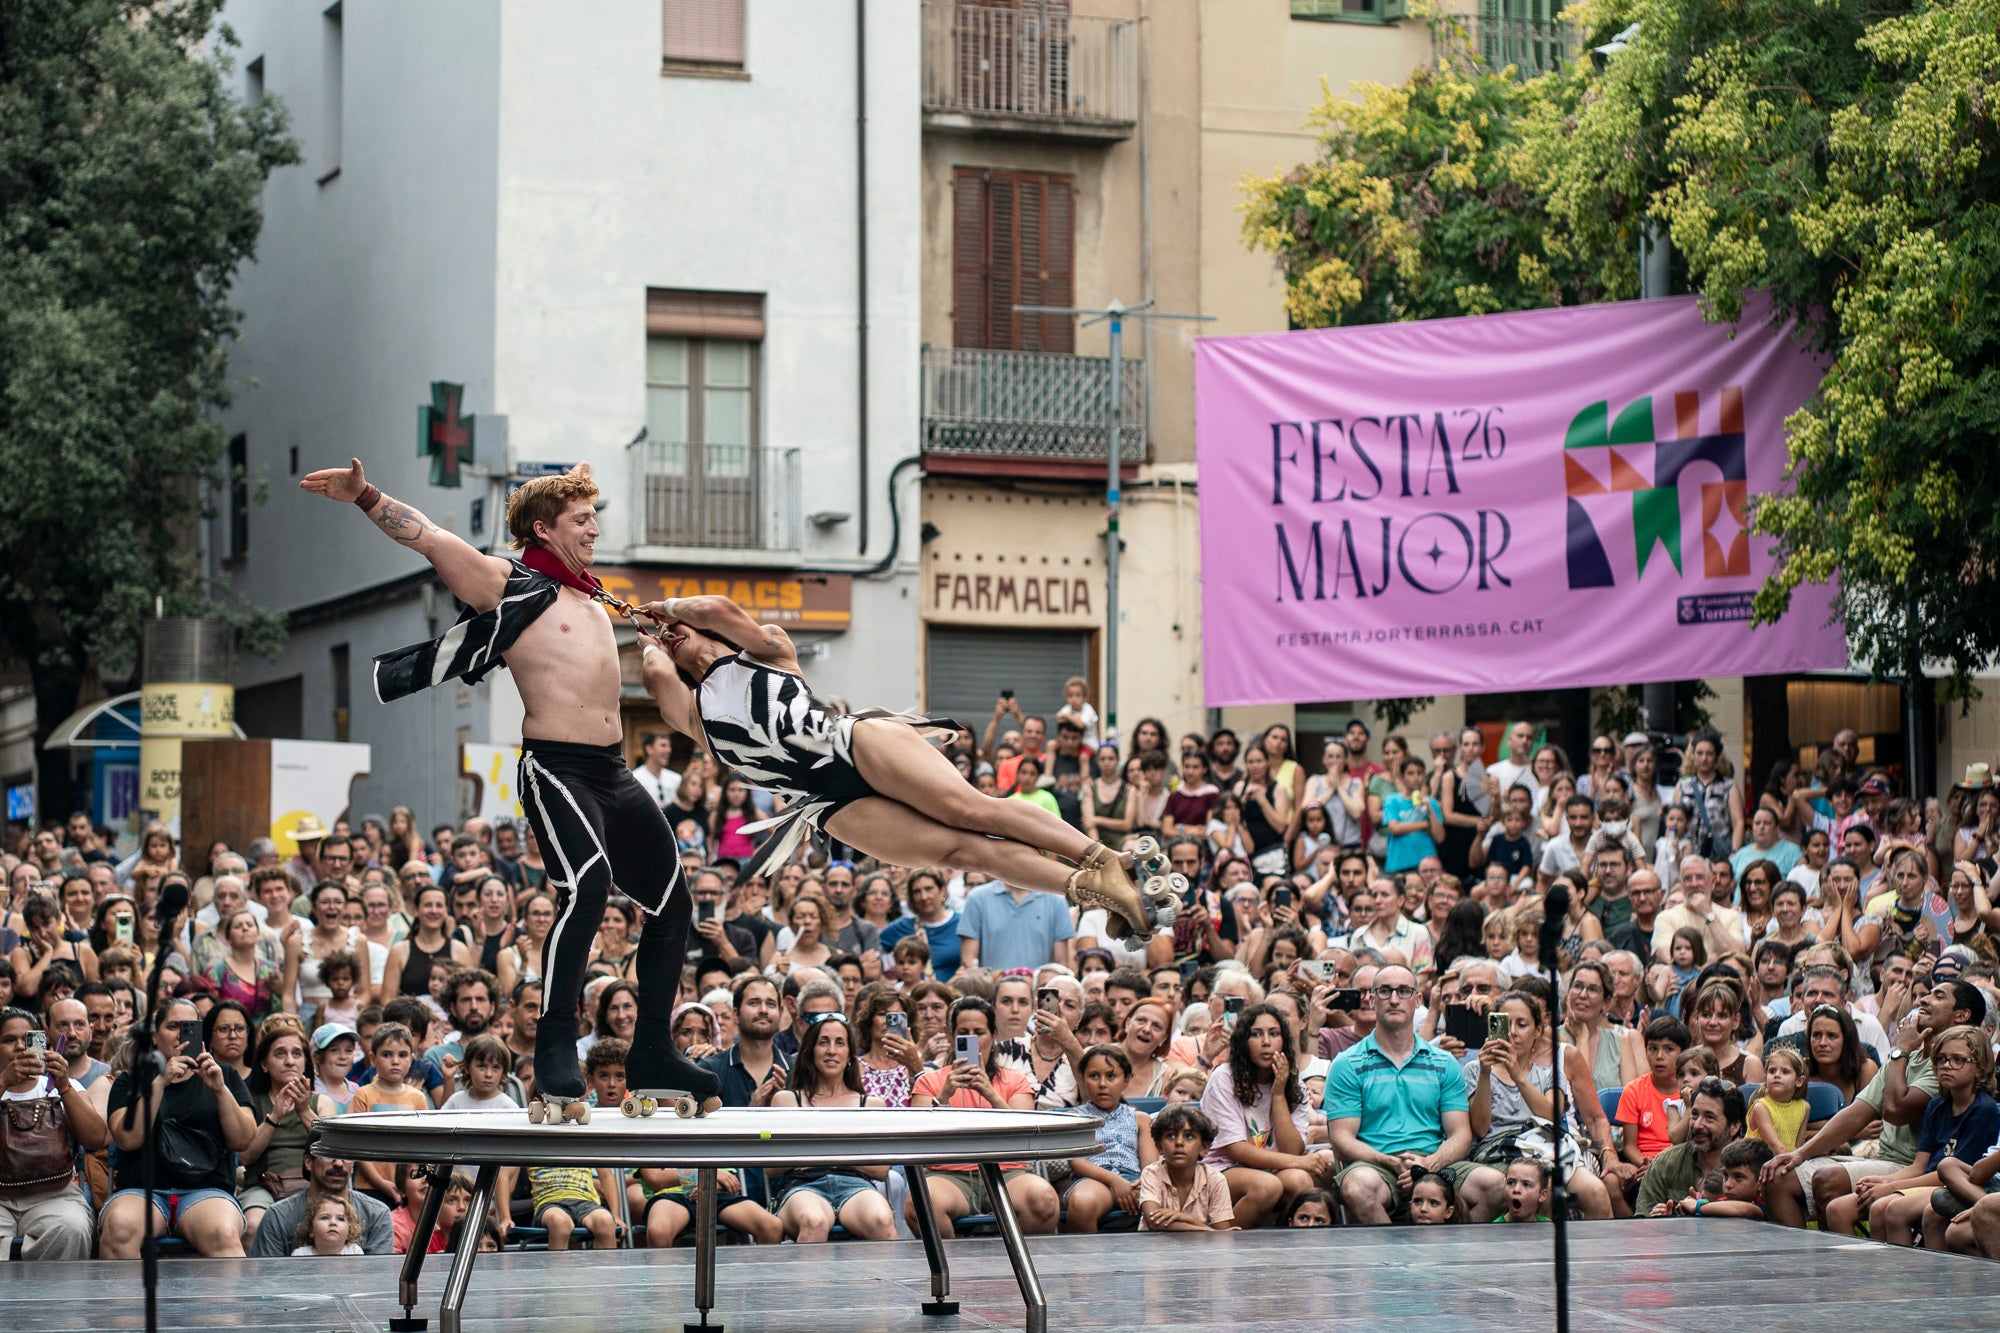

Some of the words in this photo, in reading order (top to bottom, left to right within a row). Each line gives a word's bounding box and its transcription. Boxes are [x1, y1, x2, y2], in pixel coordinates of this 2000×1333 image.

[1275, 509, 1512, 602] MAJOR
[935, 573, 1091, 615] FARMACIA
[1699, 606, 1754, 620] Terrassa
[1276, 618, 1546, 648] FESTAMAJORTERRASSA.CAT
[144, 693, 178, 707] LOVE
